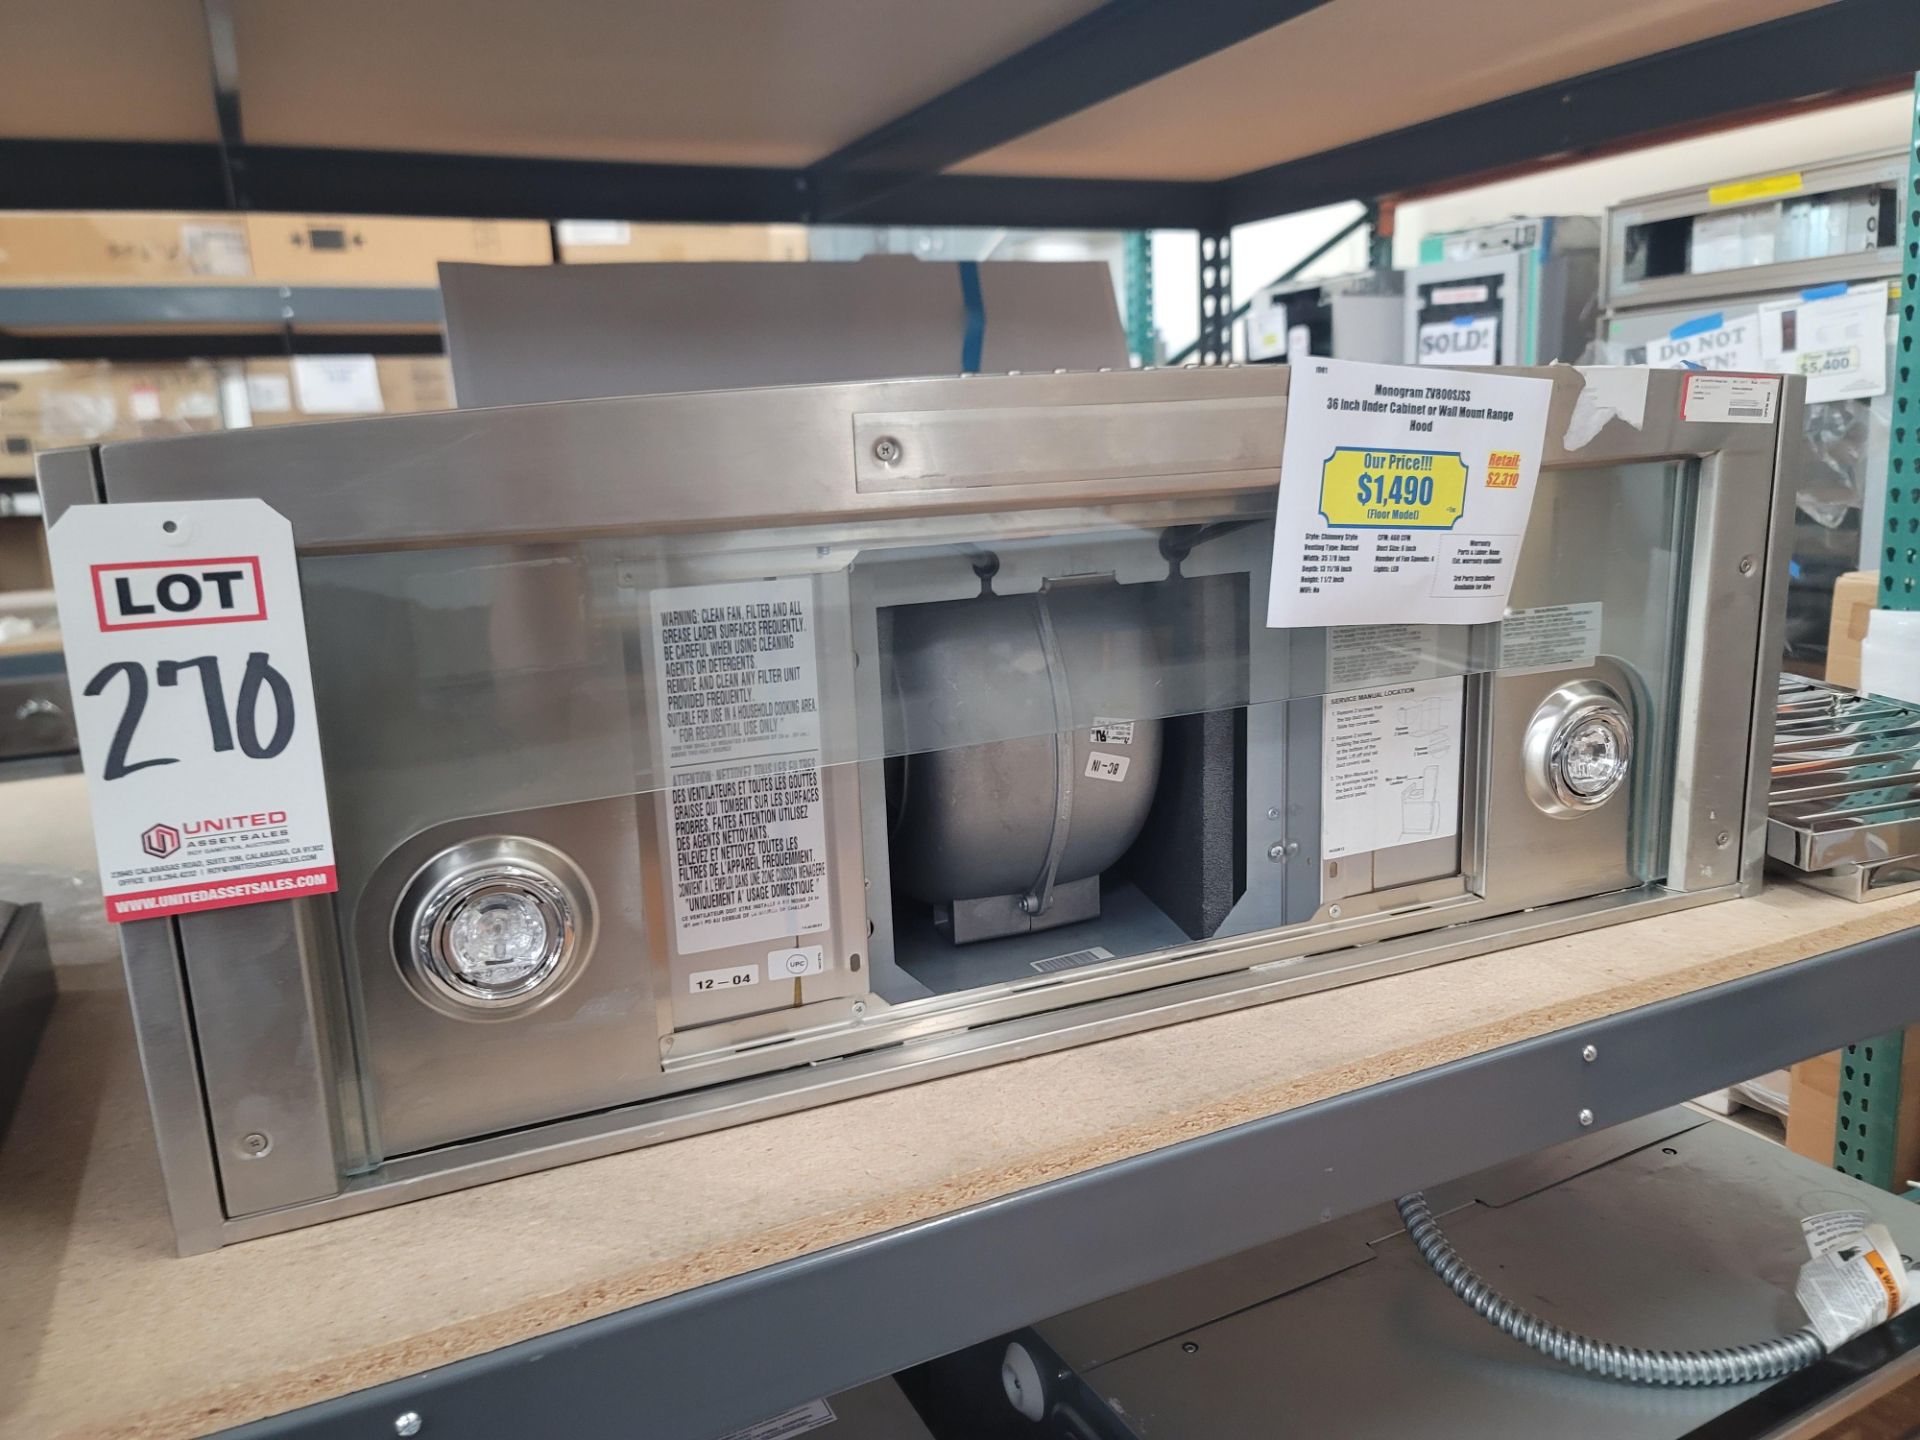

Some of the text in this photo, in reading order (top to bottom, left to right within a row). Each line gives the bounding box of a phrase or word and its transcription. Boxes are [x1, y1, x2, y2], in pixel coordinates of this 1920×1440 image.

[1421, 330, 1488, 355] SOLD!
[1661, 327, 1745, 360] DO NOT
[1801, 357, 1849, 375] $5,400
[1375, 384, 1423, 399] Monogram
[1327, 397, 1513, 422] 36 Inch Under Cabinet or Wall Mount Range
[1410, 420, 1433, 432] Hood
[1364, 453, 1433, 471] Our Price!!!
[1489, 454, 1520, 467] Retail:
[1357, 472, 1433, 507] $1,490
[1367, 509, 1419, 520] (Floor Model)
[115, 571, 243, 616] LOT
[660, 609, 699, 626] WARNING:
[702, 607, 724, 623] CLEAN
[746, 604, 770, 619] FILTER
[773, 602, 787, 617] AND
[790, 601, 802, 616] ALL
[662, 628, 691, 643] GREASE
[694, 625, 716, 641] LADEN
[720, 622, 756, 638] SURFACES
[664, 635, 794, 660] BE CAREFUL WHEN USING CLEANING
[666, 661, 694, 677] AGENTS
[697, 660, 707, 674] OR
[667, 667, 800, 694] REMOVE AND CLEAN ANY FILTER UNIT
[668, 693, 704, 710] PROVIDED
[1331, 696, 1356, 704] SERVICE
[1384, 688, 1415, 696] LOCATION
[83, 652, 295, 781] 270
[668, 710, 695, 727] SUITABLE
[698, 709, 709, 724] FOR
[711, 708, 722, 723] USE
[725, 707, 730, 721] IN
[733, 706, 737, 720] A
[738, 703, 772, 720] HOUSEHOLD
[775, 700, 799, 716] COOKING
[696, 723, 742, 740] RESIDENTIAL
[744, 721, 758, 736] USE
[673, 772, 817, 804] DES VENTILATEURS ET TOUTES LES GOUTTES
[674, 789, 819, 820] GRAISSE QUI TOMBENT SUR LES SURFACES
[183, 811, 287, 835] UNITED
[713, 815, 736, 831] FAITES
[739, 810, 776, 828] ATTENTION
[779, 805, 808, 822] UTILISEZ
[187, 829, 288, 848] ASSET SALES
[677, 826, 769, 851] DES AGENTS NETTOYANTS.
[678, 837, 798, 866] ENLEVEZ ET NETTOYEZ TOUTES LES
[679, 864, 707, 881] FILTRES
[710, 863, 718, 877] DE
[721, 857, 760, 875] L'APPAREIL
[115, 874, 328, 913] WWW.UNITEDASSETSALES.COM
[747, 887, 769, 902] USAGE
[790, 960, 804, 968] UPC
